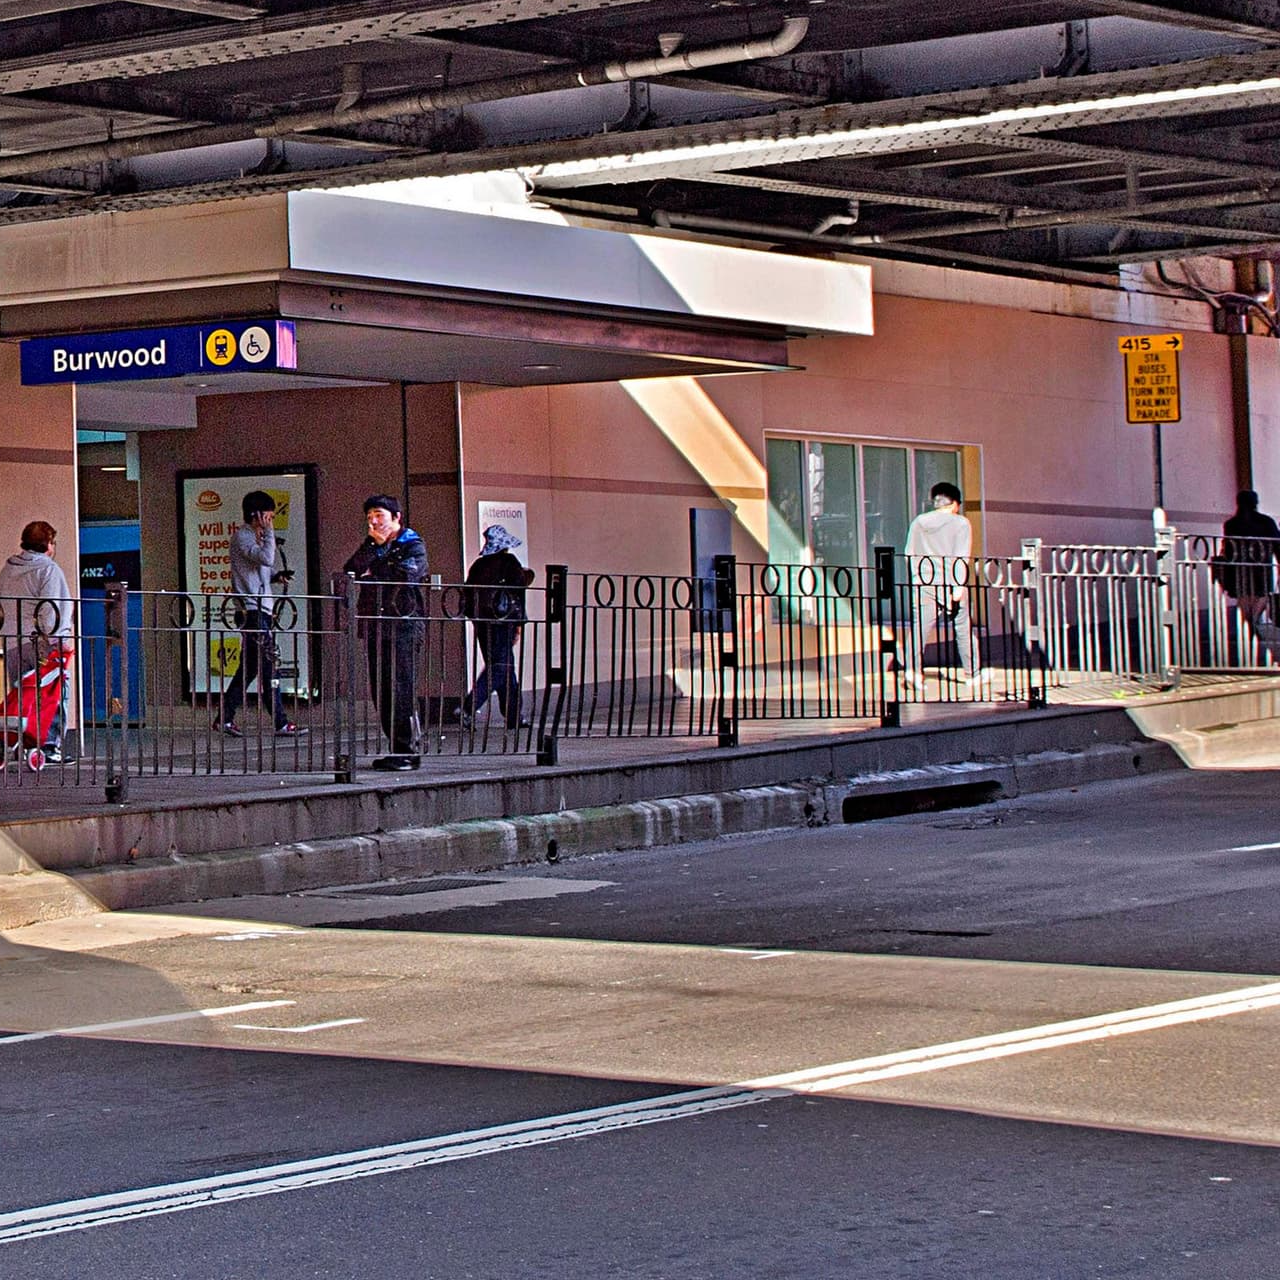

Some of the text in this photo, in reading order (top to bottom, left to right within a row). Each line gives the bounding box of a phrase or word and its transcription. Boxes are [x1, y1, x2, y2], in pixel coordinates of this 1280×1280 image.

[1121, 337, 1151, 350] 415
[53, 339, 166, 372] Burwood
[1144, 353, 1159, 362] STA
[1138, 364, 1167, 374] BUSES
[1134, 375, 1171, 385] NO LEFT
[1130, 386, 1176, 396] TURN INTO
[1135, 398, 1171, 407] RAILWAY
[1136, 409, 1171, 419] PARADE
[200, 494, 217, 503] MLC
[483, 507, 522, 519] Attention
[198, 521, 240, 536] Will th
[199, 540, 230, 552] supe
[199, 553, 231, 565] incre
[81, 567, 104, 577] ANZ
[200, 568, 217, 580] be
[200, 583, 220, 594] for
